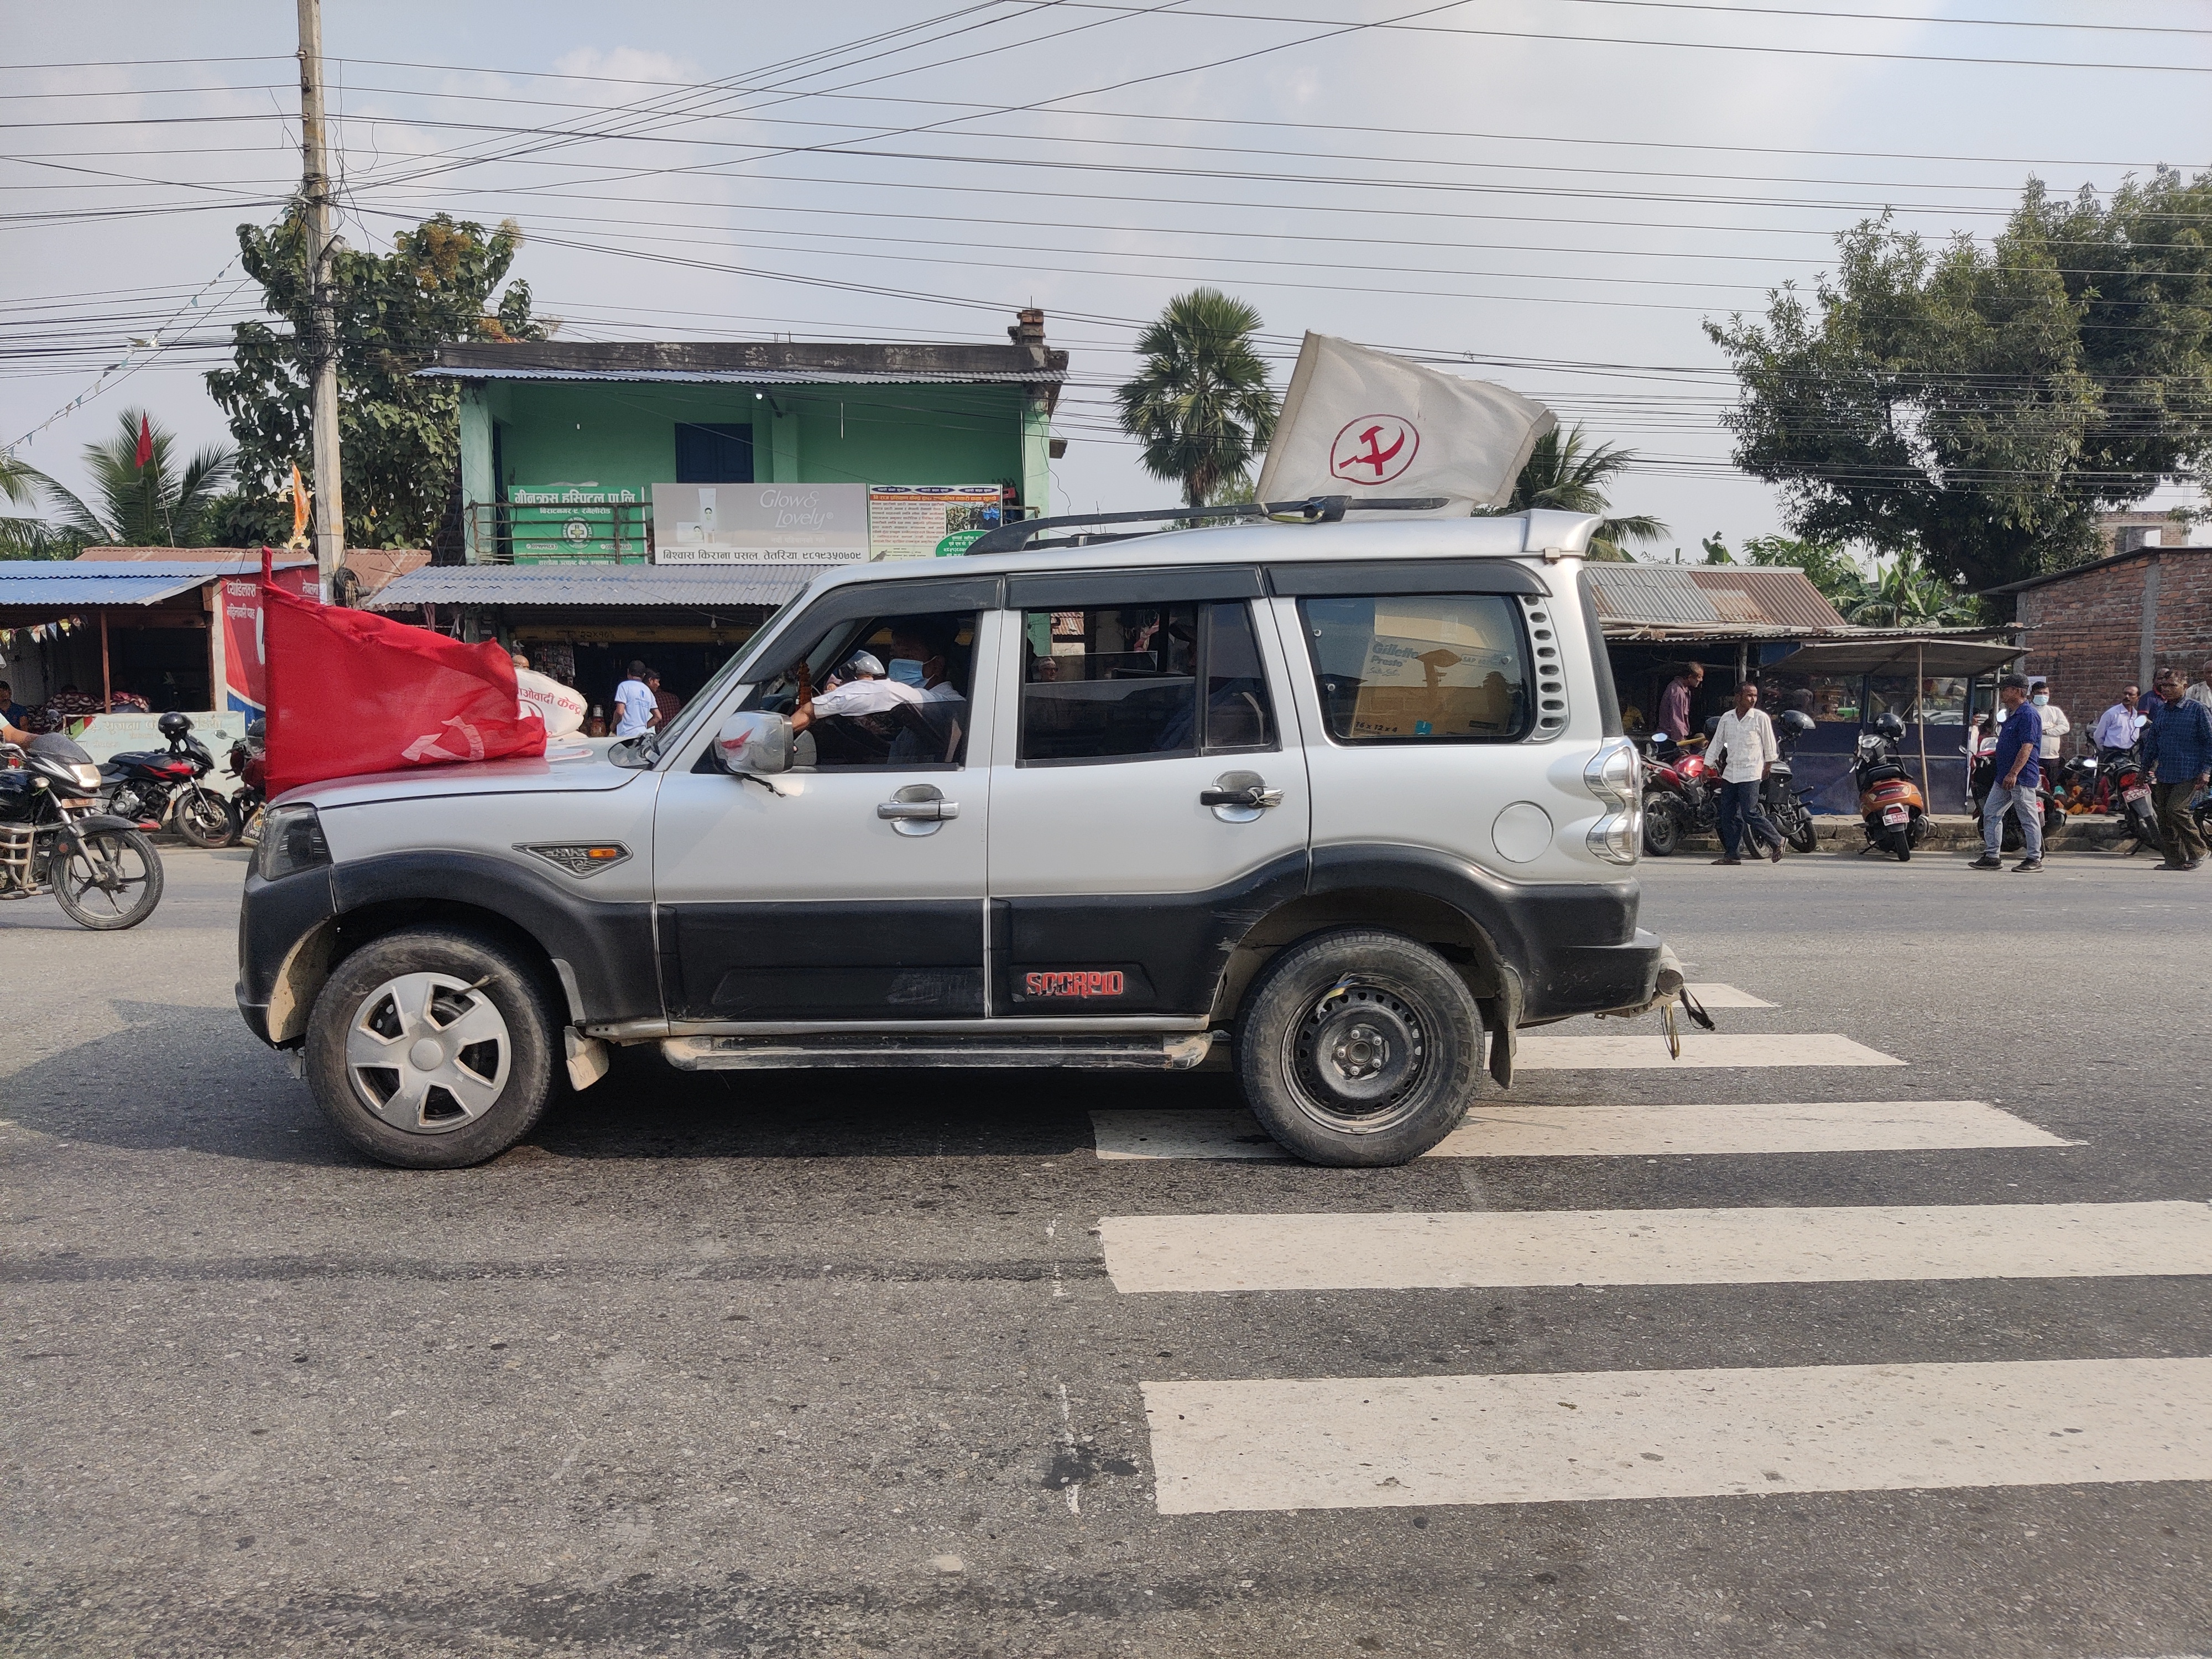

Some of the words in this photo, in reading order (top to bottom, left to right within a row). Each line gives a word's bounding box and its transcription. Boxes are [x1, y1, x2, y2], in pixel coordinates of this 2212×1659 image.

[775, 508, 825, 530] Lovely
[664, 550, 695, 560] बिश्वास
[698, 550, 731, 560] किराना
[1373, 641, 1420, 659] Gillette
[518, 687, 555, 705] ाओवादी
